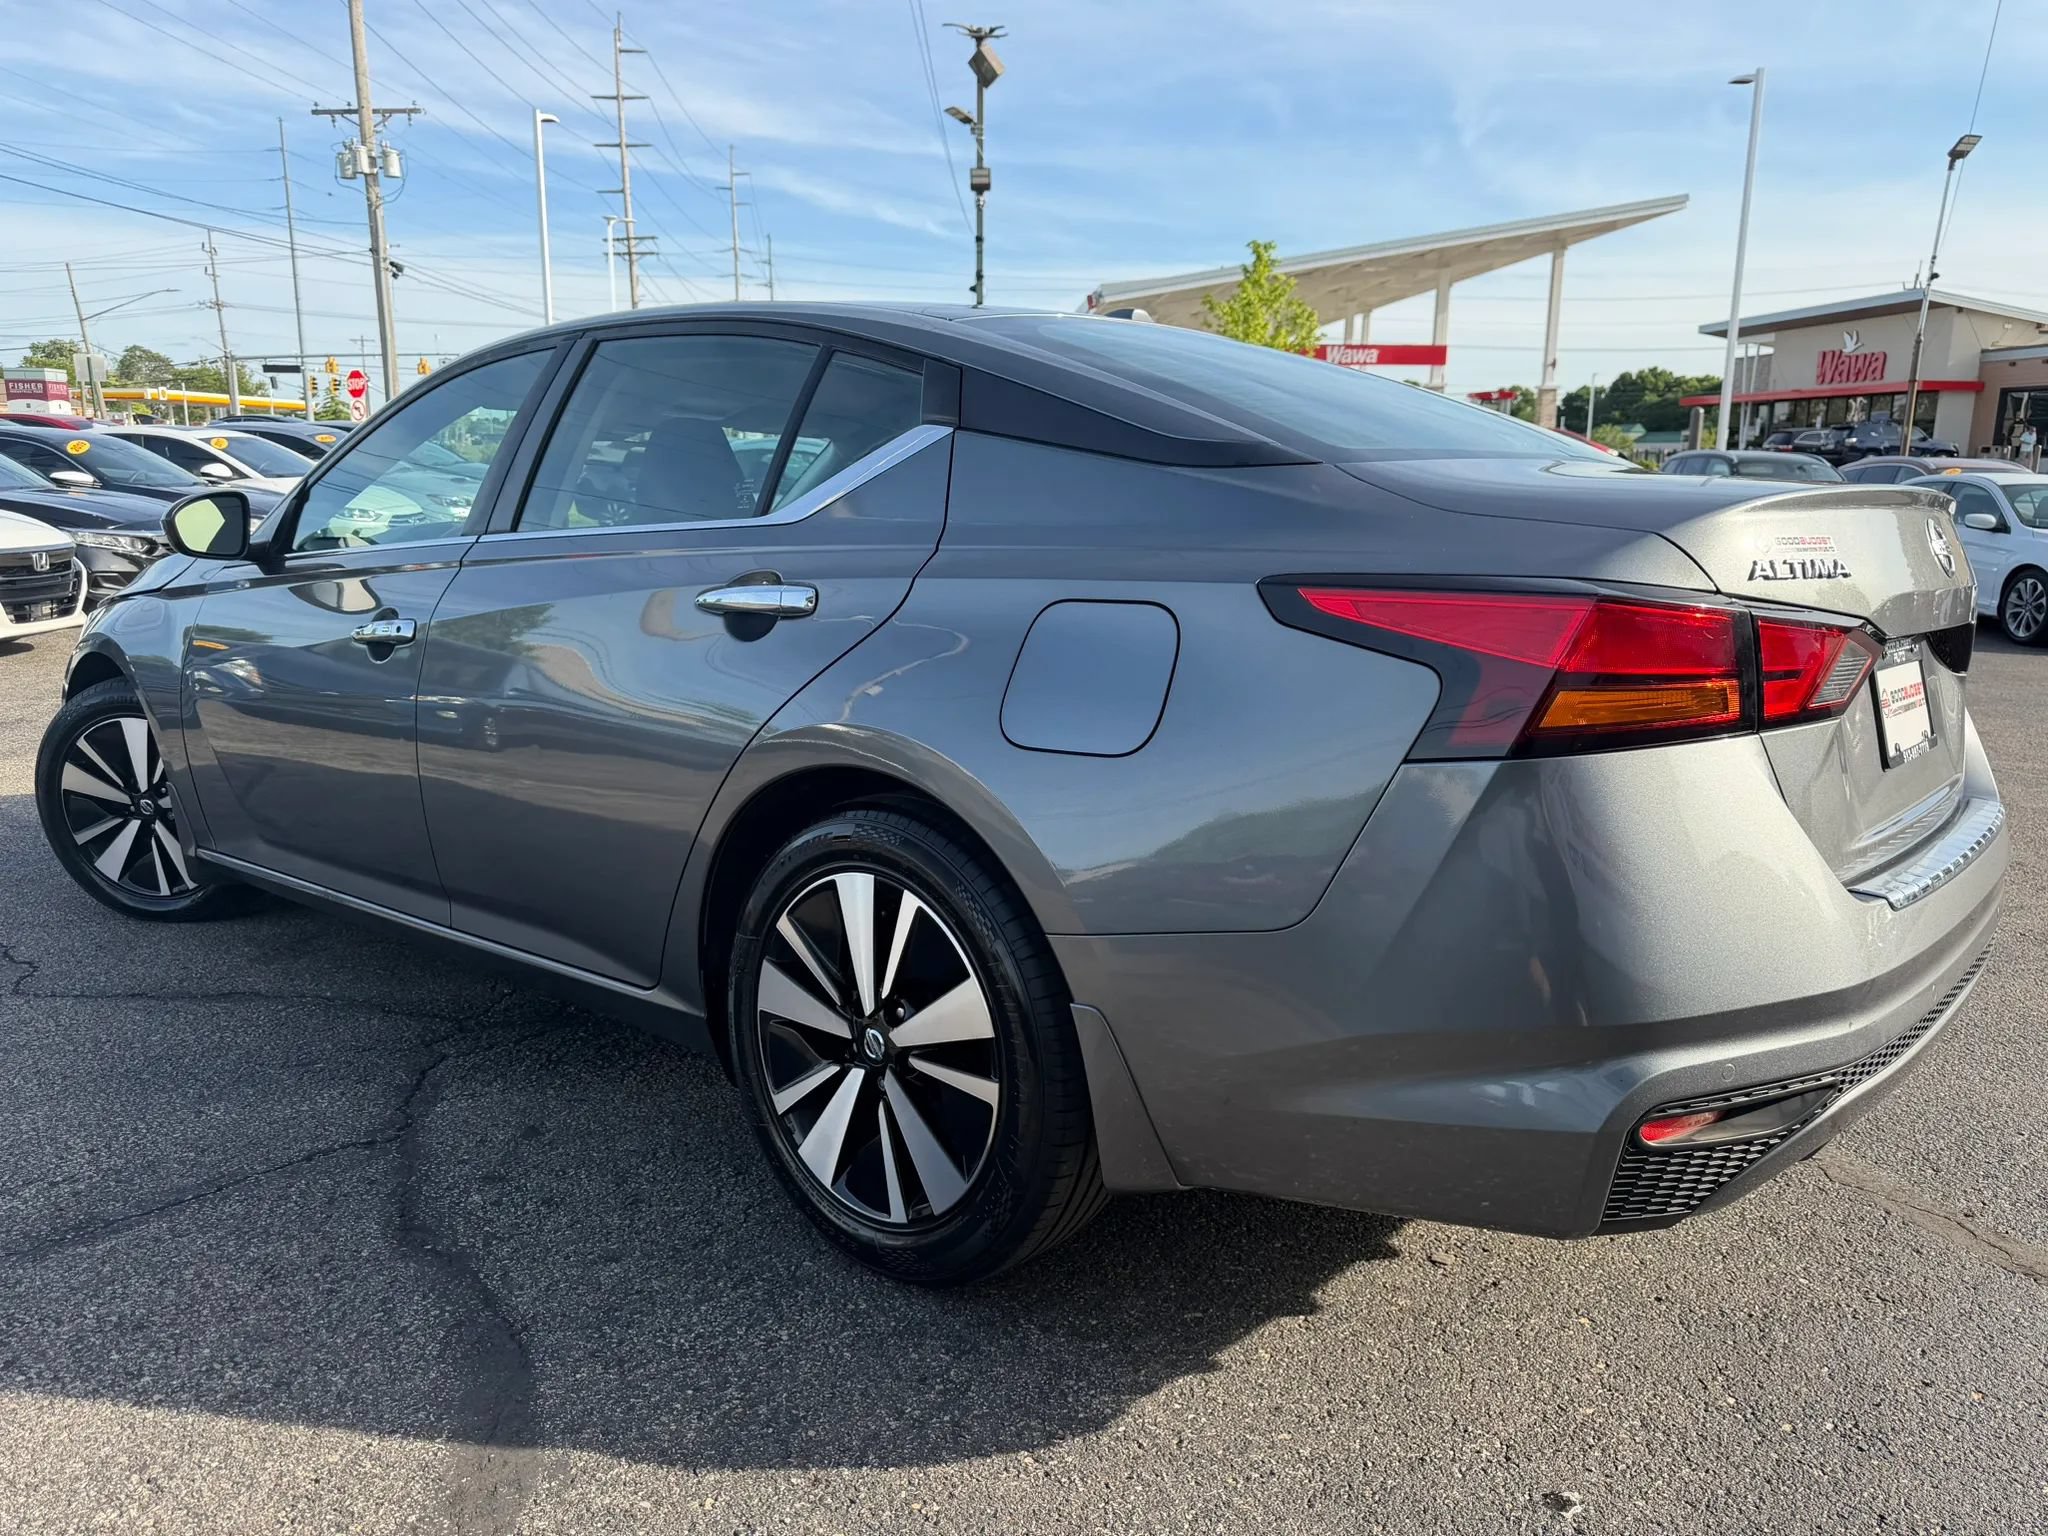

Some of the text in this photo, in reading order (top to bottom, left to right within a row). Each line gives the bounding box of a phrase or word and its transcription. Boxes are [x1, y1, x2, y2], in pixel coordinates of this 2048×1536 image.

[1325, 346, 1380, 364] Wawa
[1816, 350, 1887, 385] Wawa
[8, 382, 44, 390] FISHER
[347, 377, 365, 390] STOP
[1747, 559, 1852, 582] ALTIMA
